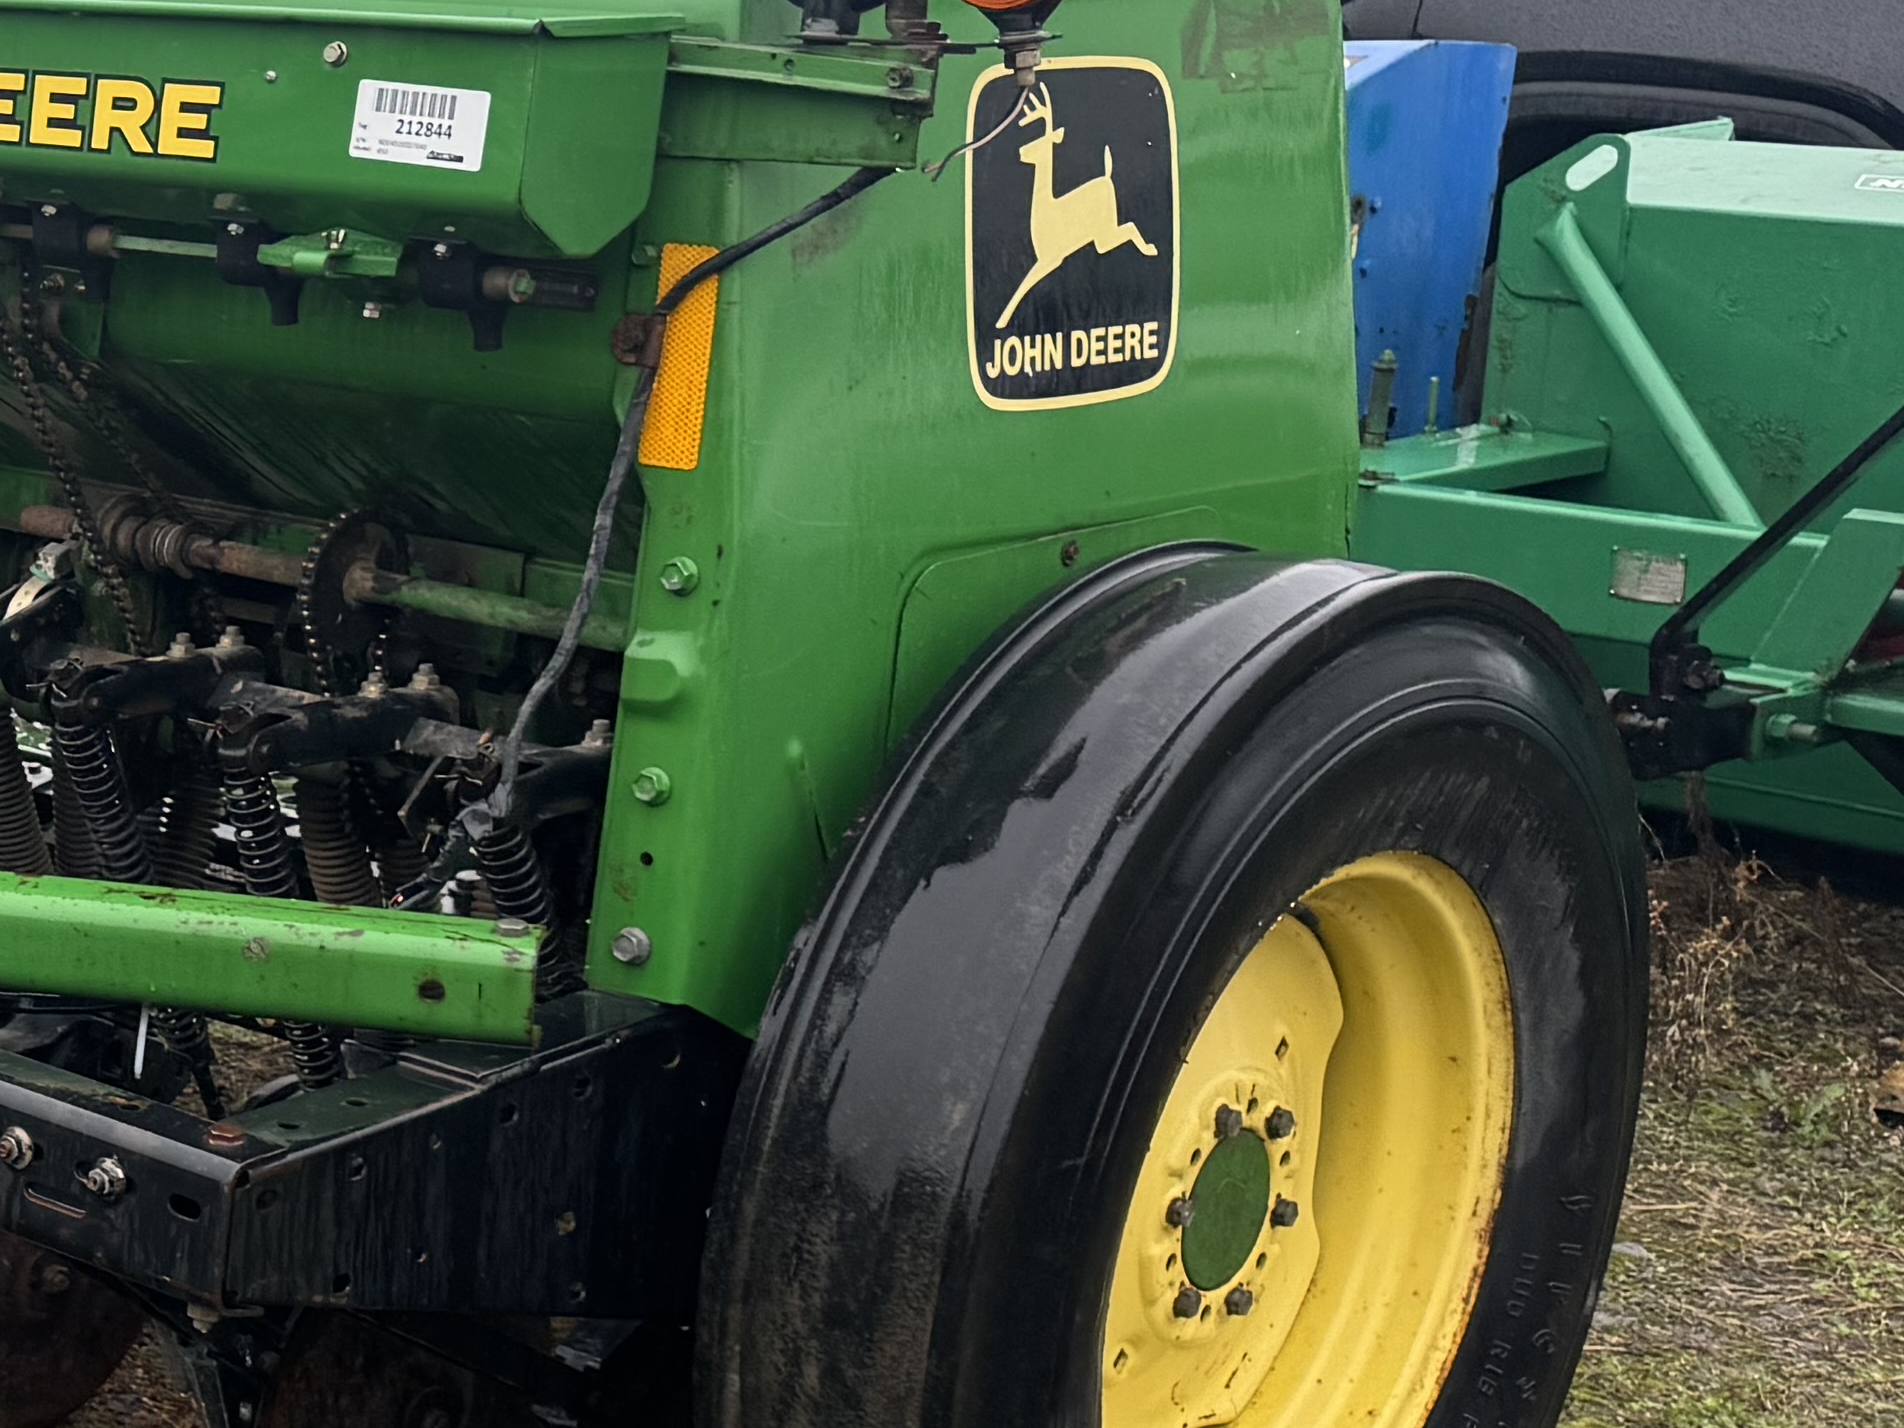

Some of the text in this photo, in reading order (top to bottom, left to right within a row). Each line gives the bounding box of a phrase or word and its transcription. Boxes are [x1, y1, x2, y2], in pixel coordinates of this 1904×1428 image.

[395, 118, 453, 140] 212844
[985, 321, 1159, 378] JOHN DEERE
